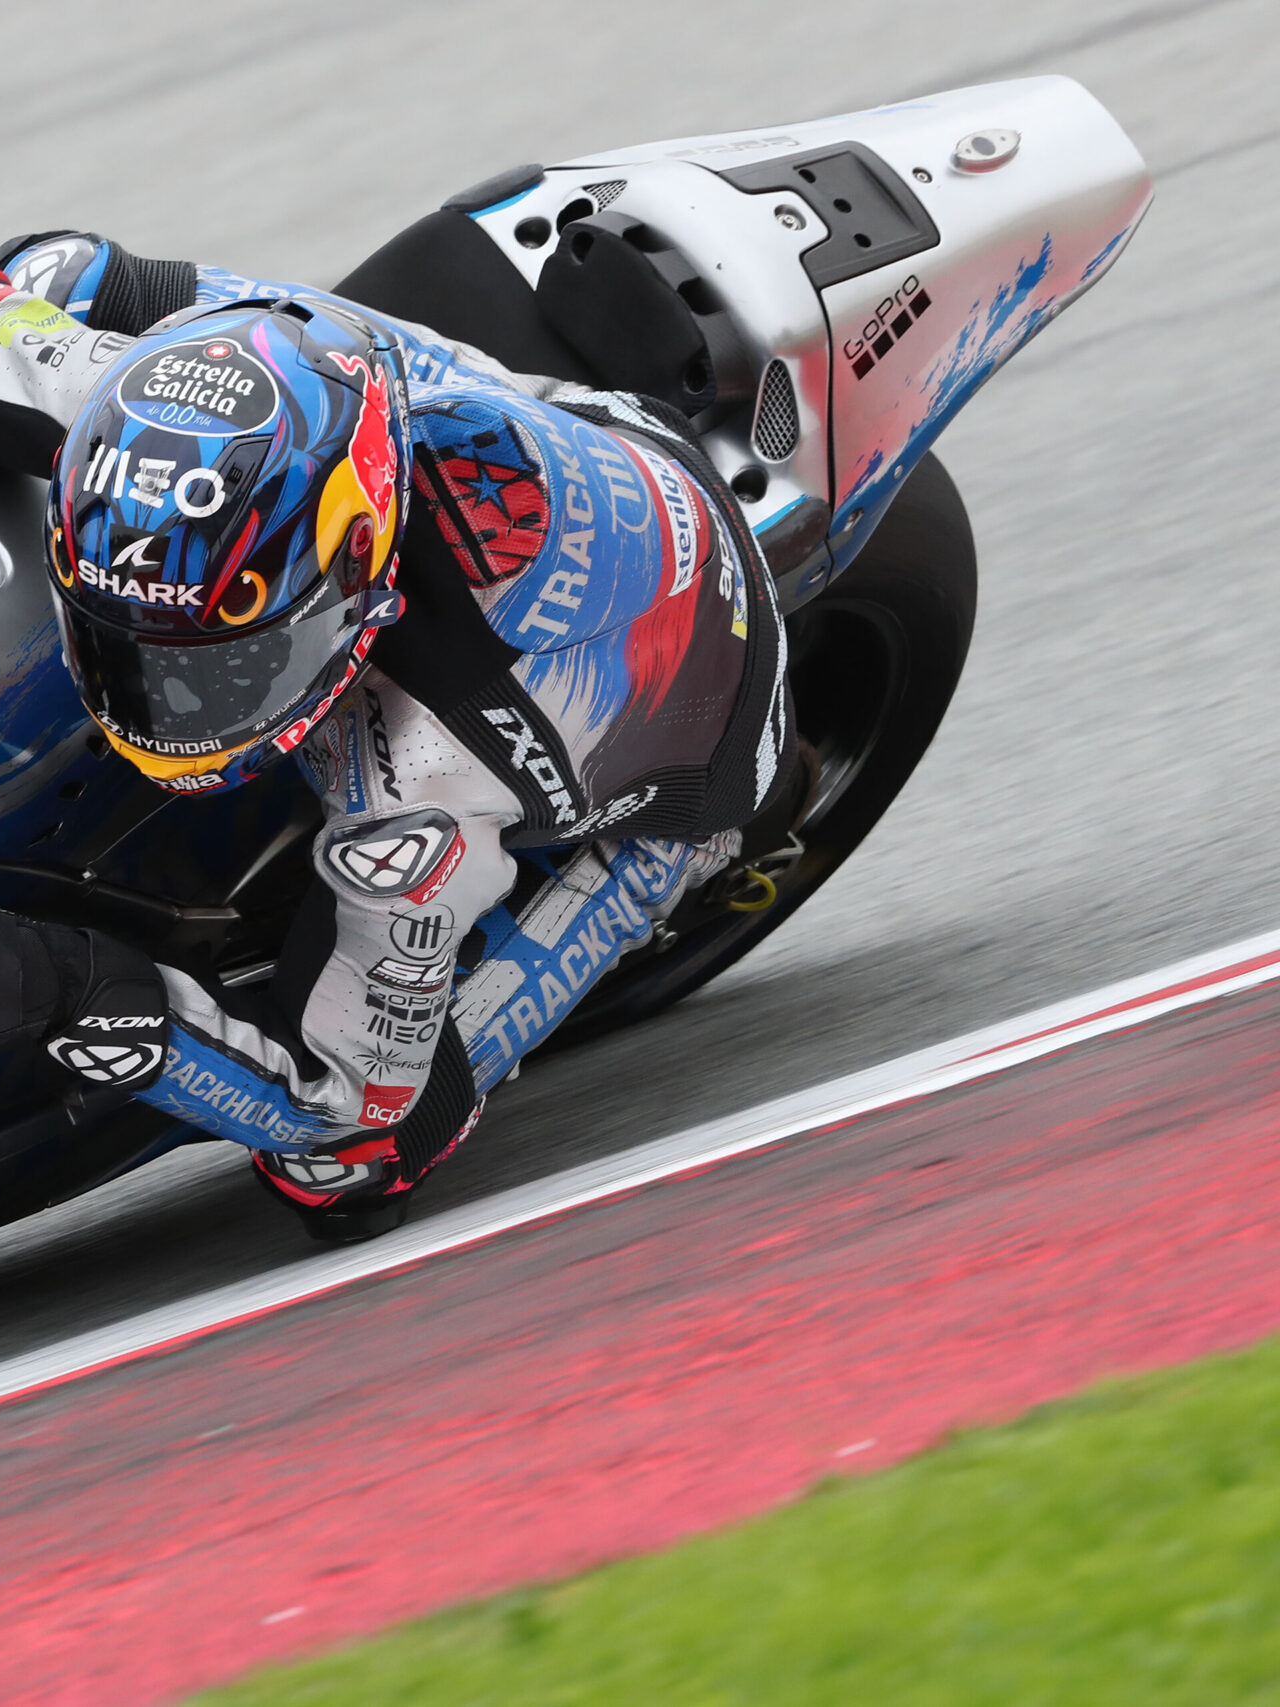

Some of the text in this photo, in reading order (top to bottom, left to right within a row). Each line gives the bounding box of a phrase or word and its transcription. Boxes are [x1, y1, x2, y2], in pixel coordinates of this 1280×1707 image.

[843, 275, 920, 360] GoPro
[144, 374, 237, 416] Galicia
[150, 354, 255, 396] Estrella
[159, 402, 196, 424] 0,0
[78, 559, 204, 606] SHARK
[290, 582, 329, 626] SHARK
[128, 732, 223, 755] HYUNDAI
[481, 707, 577, 824] IXON
[162, 1046, 313, 1145] RACKHOUSE
